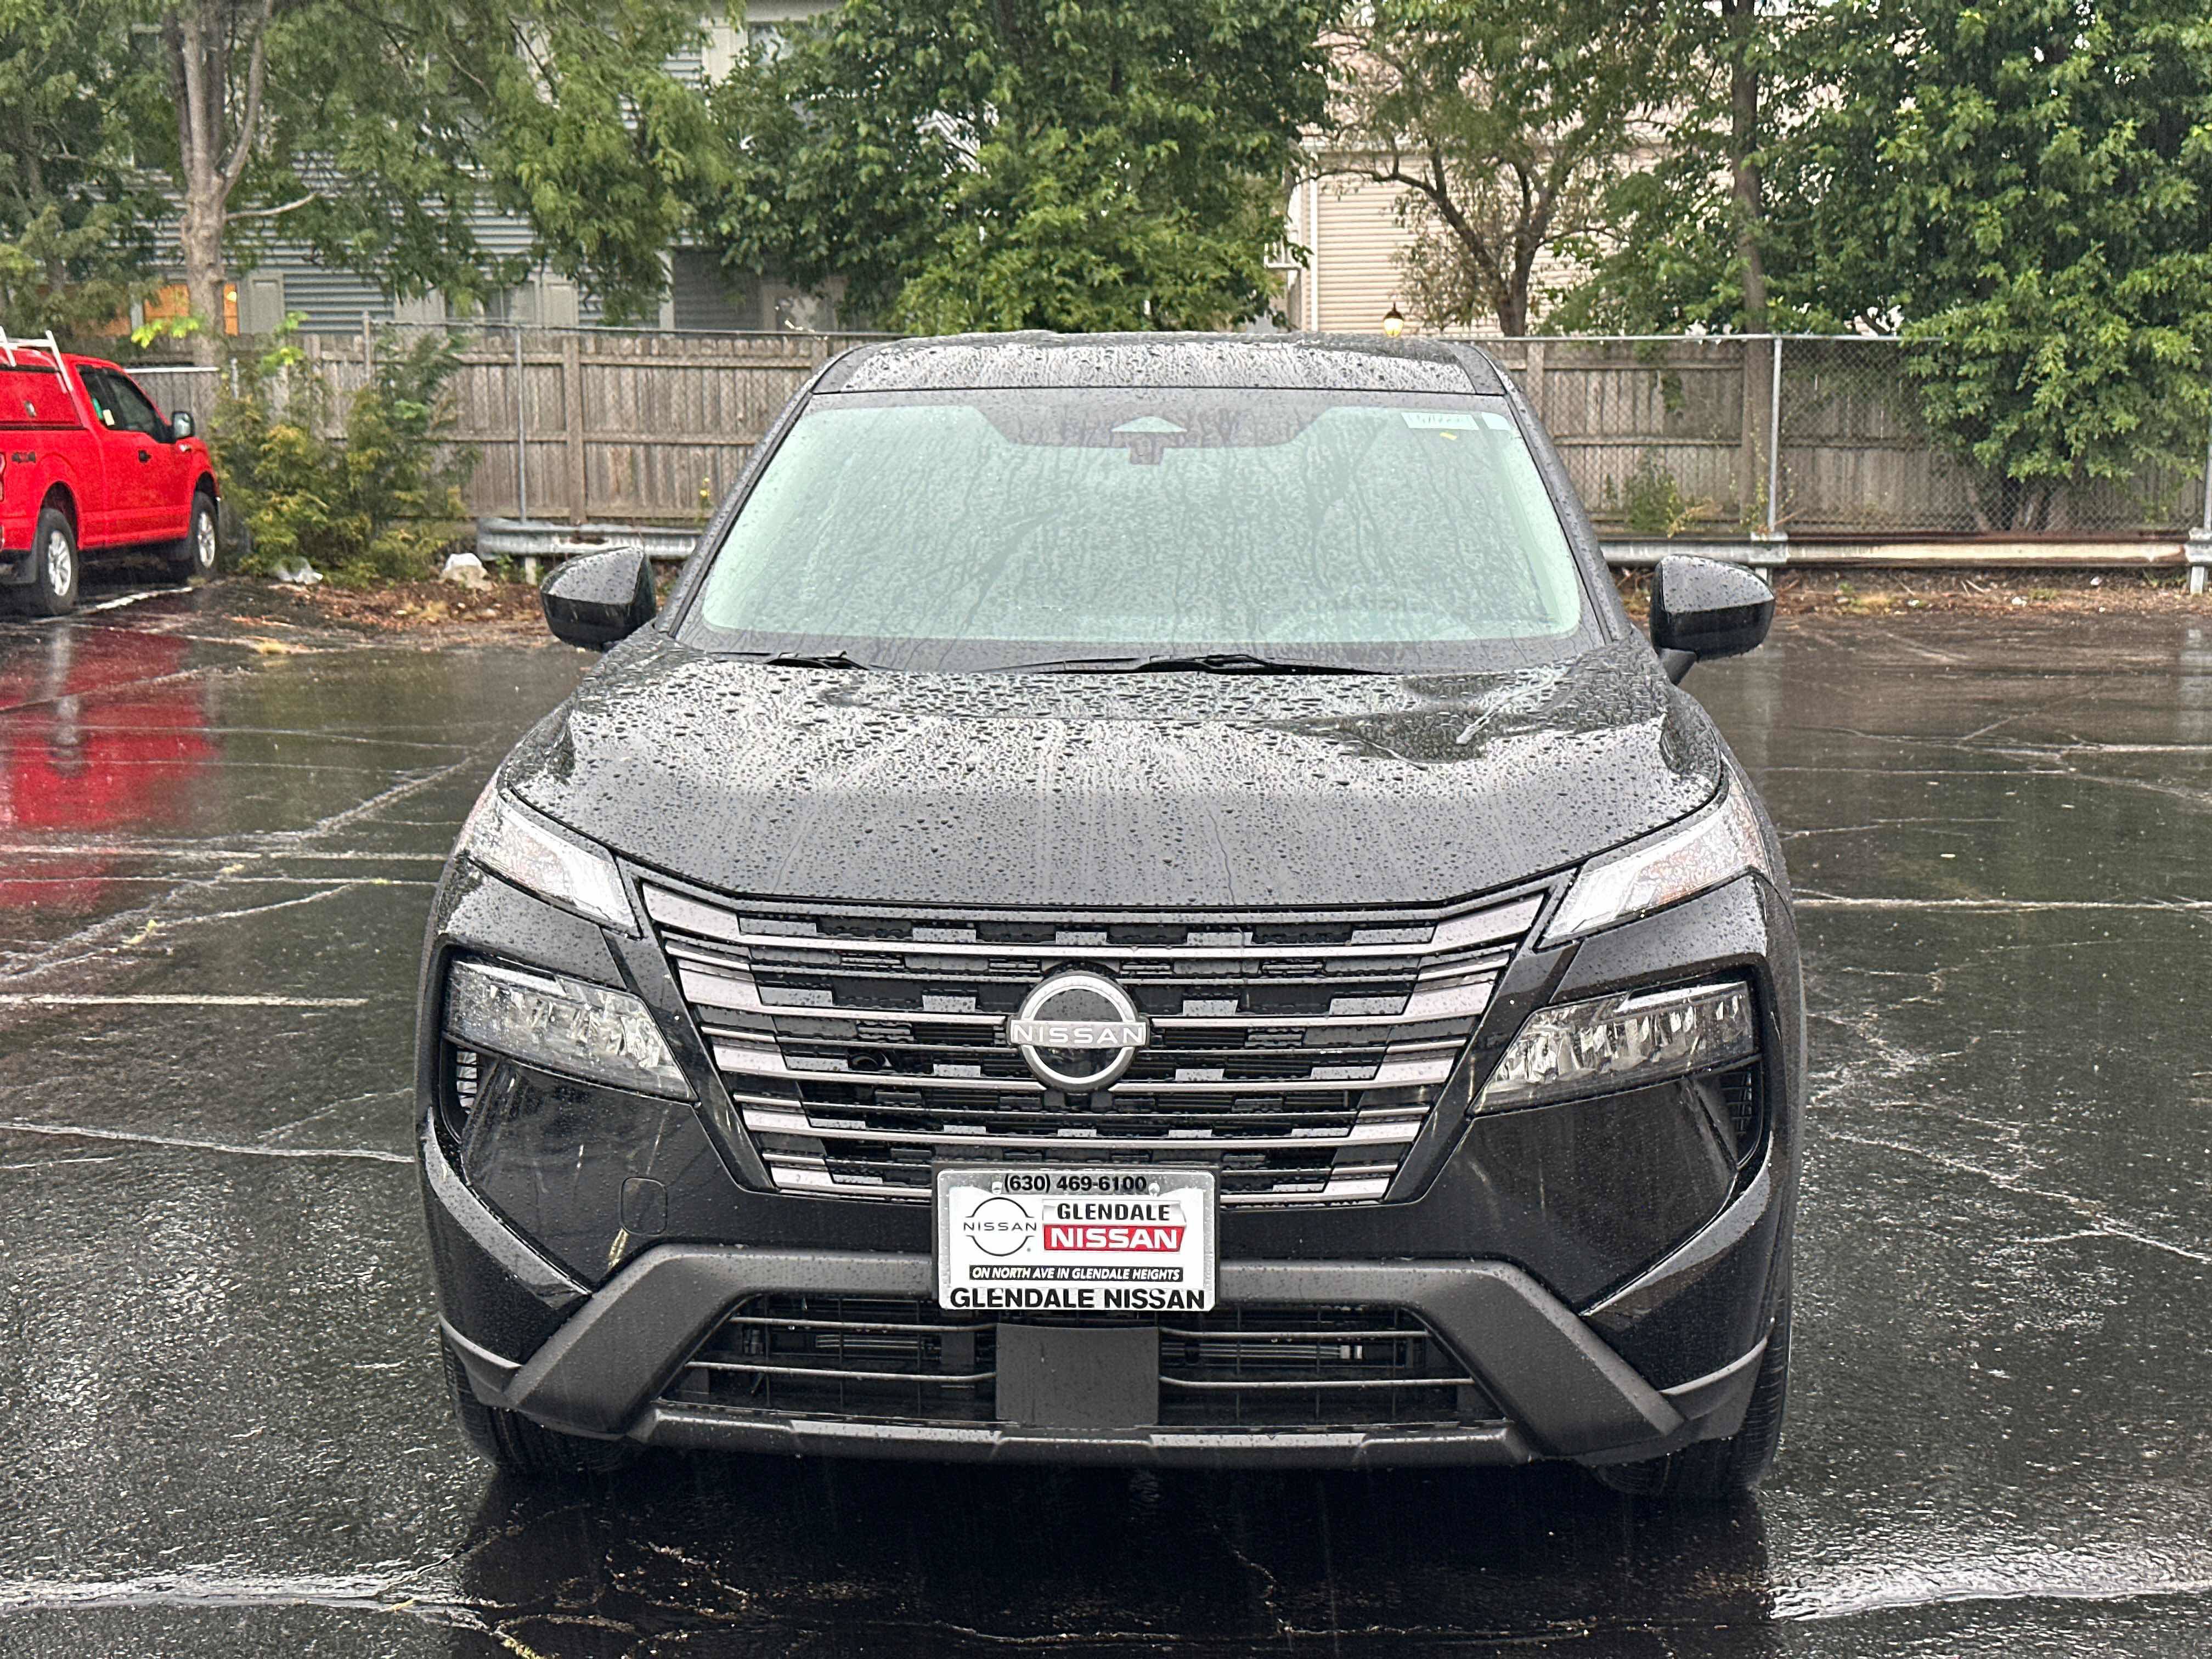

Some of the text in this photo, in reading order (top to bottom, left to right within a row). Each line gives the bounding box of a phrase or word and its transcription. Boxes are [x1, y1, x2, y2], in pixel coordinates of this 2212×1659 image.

[1014, 1024, 1142, 1043] NISSAN
[1004, 1173, 1147, 1193] (630) 469-6100
[1057, 1203, 1171, 1221] GLENDALE
[963, 1222, 1037, 1231] NISSAN
[1051, 1228, 1177, 1249] NISSAN
[972, 1267, 1180, 1281] ON NORTH AVE IN GLENDALE HEIGHTS
[950, 1287, 1205, 1310] GLENDALE NISSAN
